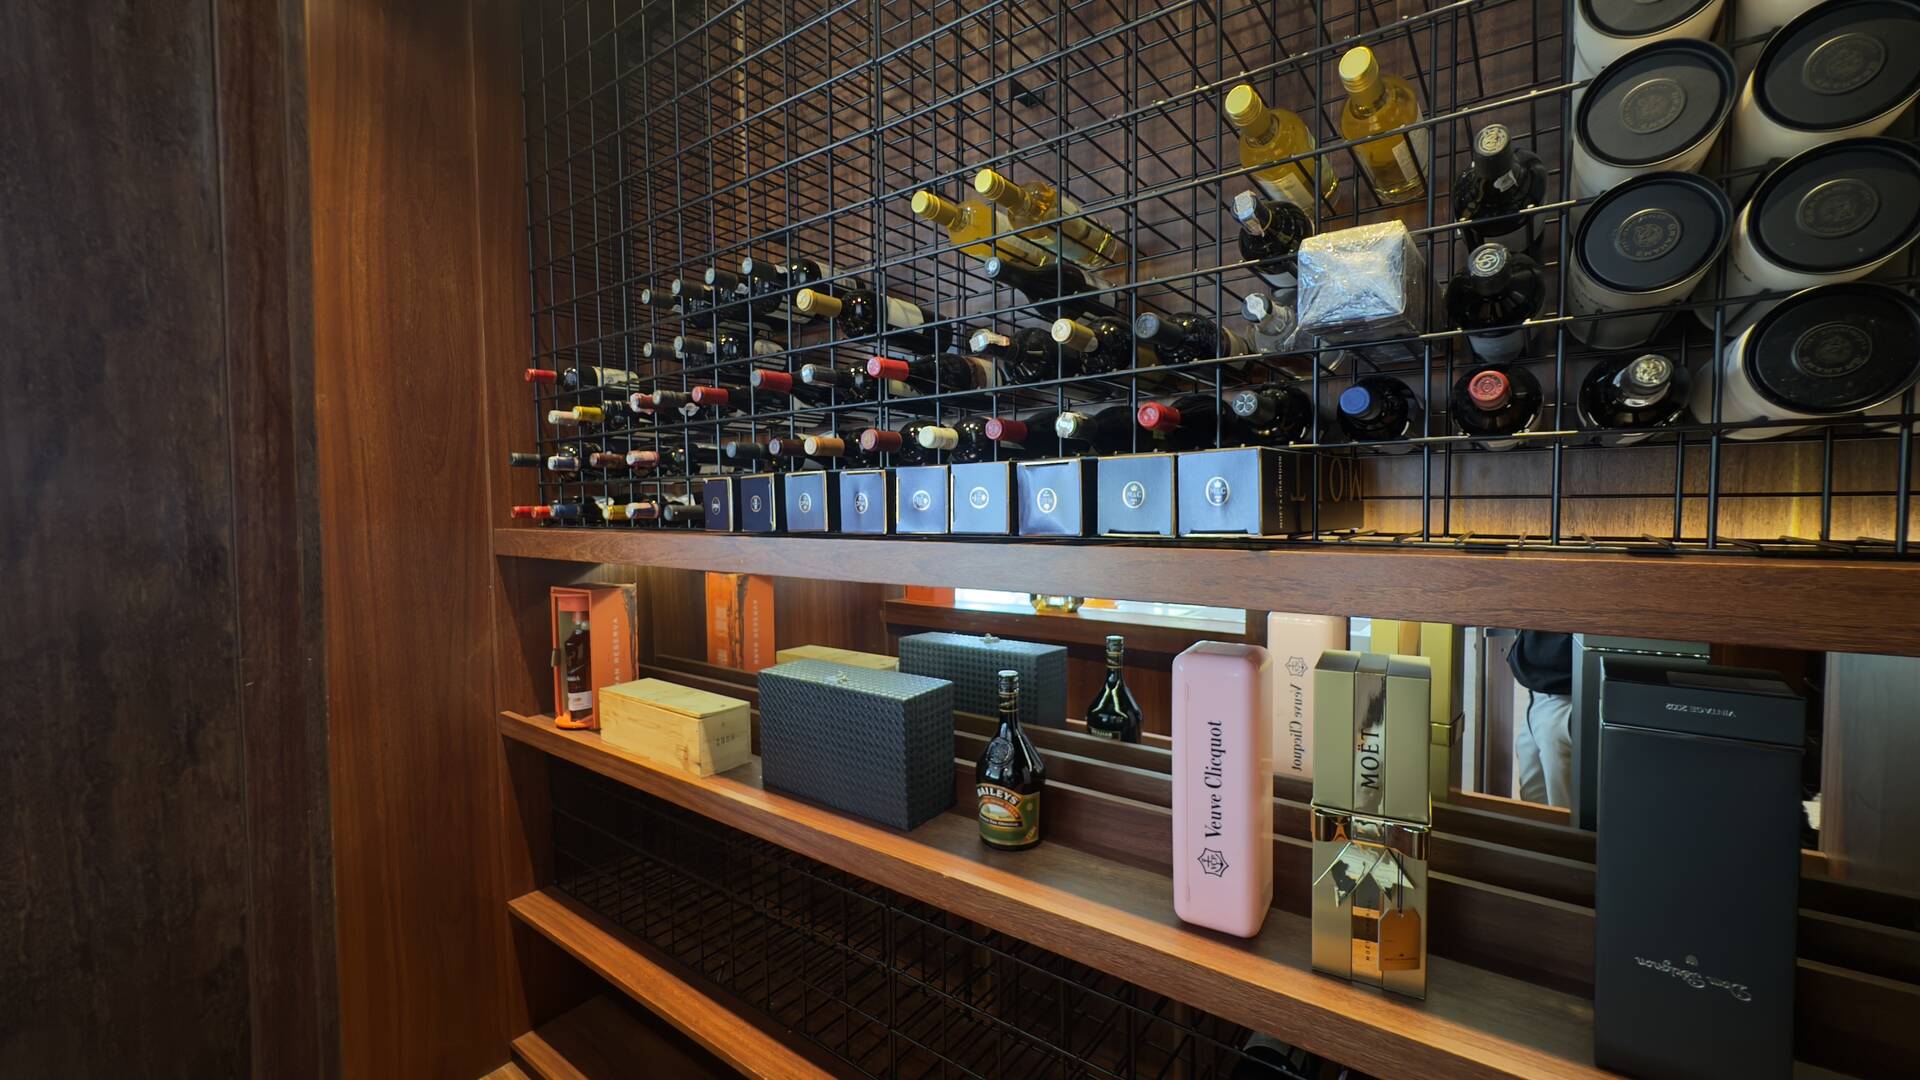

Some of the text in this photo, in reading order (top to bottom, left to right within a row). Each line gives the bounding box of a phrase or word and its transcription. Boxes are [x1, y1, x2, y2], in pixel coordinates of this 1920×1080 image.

[1203, 720, 1226, 838] Veuve Clicquot
[1357, 728, 1380, 790] MOËT
[976, 786, 1021, 805] BAILEYS
